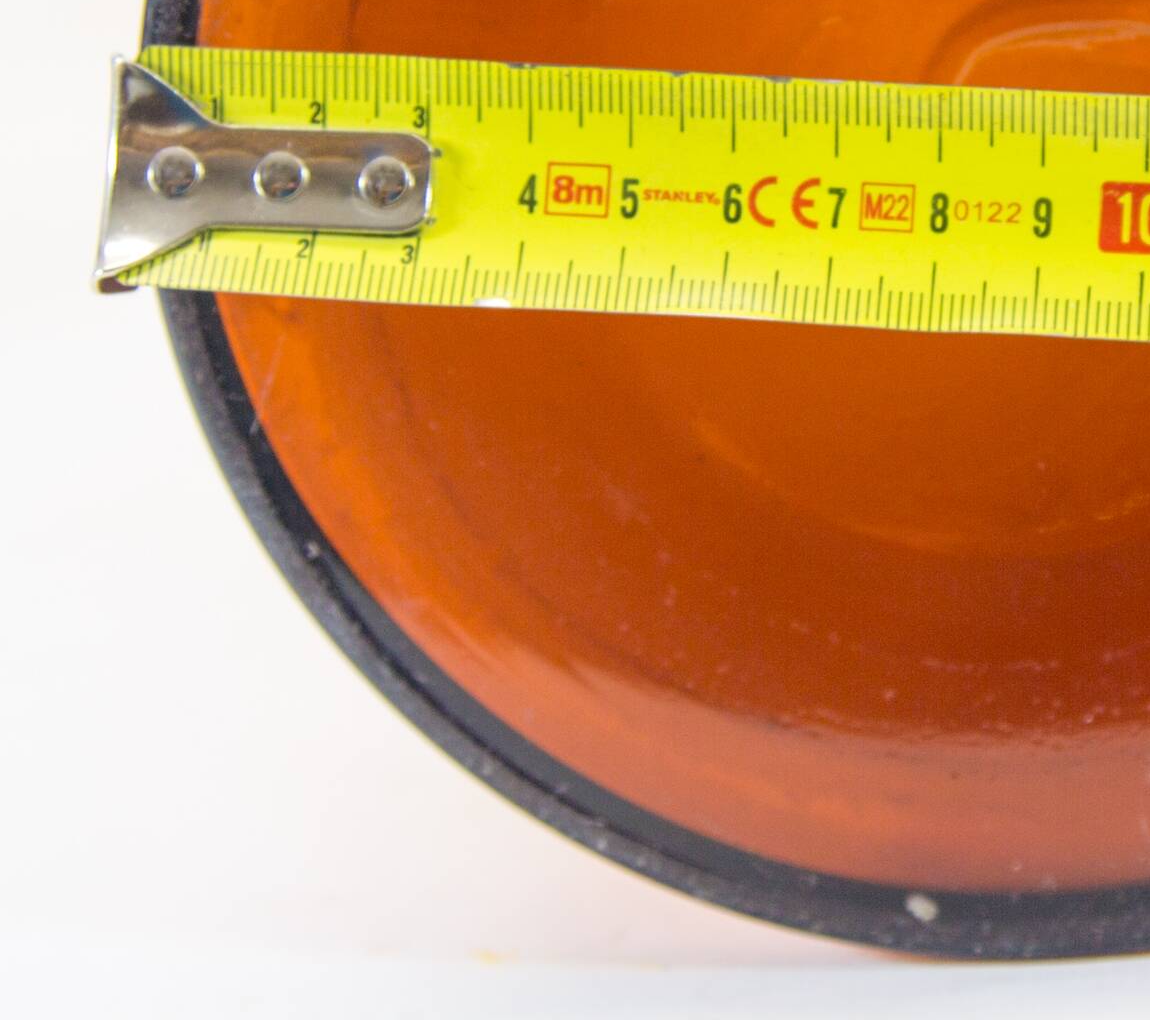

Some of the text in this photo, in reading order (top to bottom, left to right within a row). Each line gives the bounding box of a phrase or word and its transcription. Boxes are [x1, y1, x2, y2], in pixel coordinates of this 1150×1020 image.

[209, 97, 425, 128] 1 2 3
[518, 174, 538, 214] 4
[552, 175, 604, 206] 8m
[620, 178, 639, 219] 5
[723, 184, 742, 223] 6
[828, 187, 847, 228] 7
[865, 193, 910, 221] M22
[930, 193, 949, 233] 8
[954, 200, 1022, 224] 0122
[1033, 197, 1053, 238] 9
[298, 239, 310, 259] 2
[401, 244, 414, 264] 3
